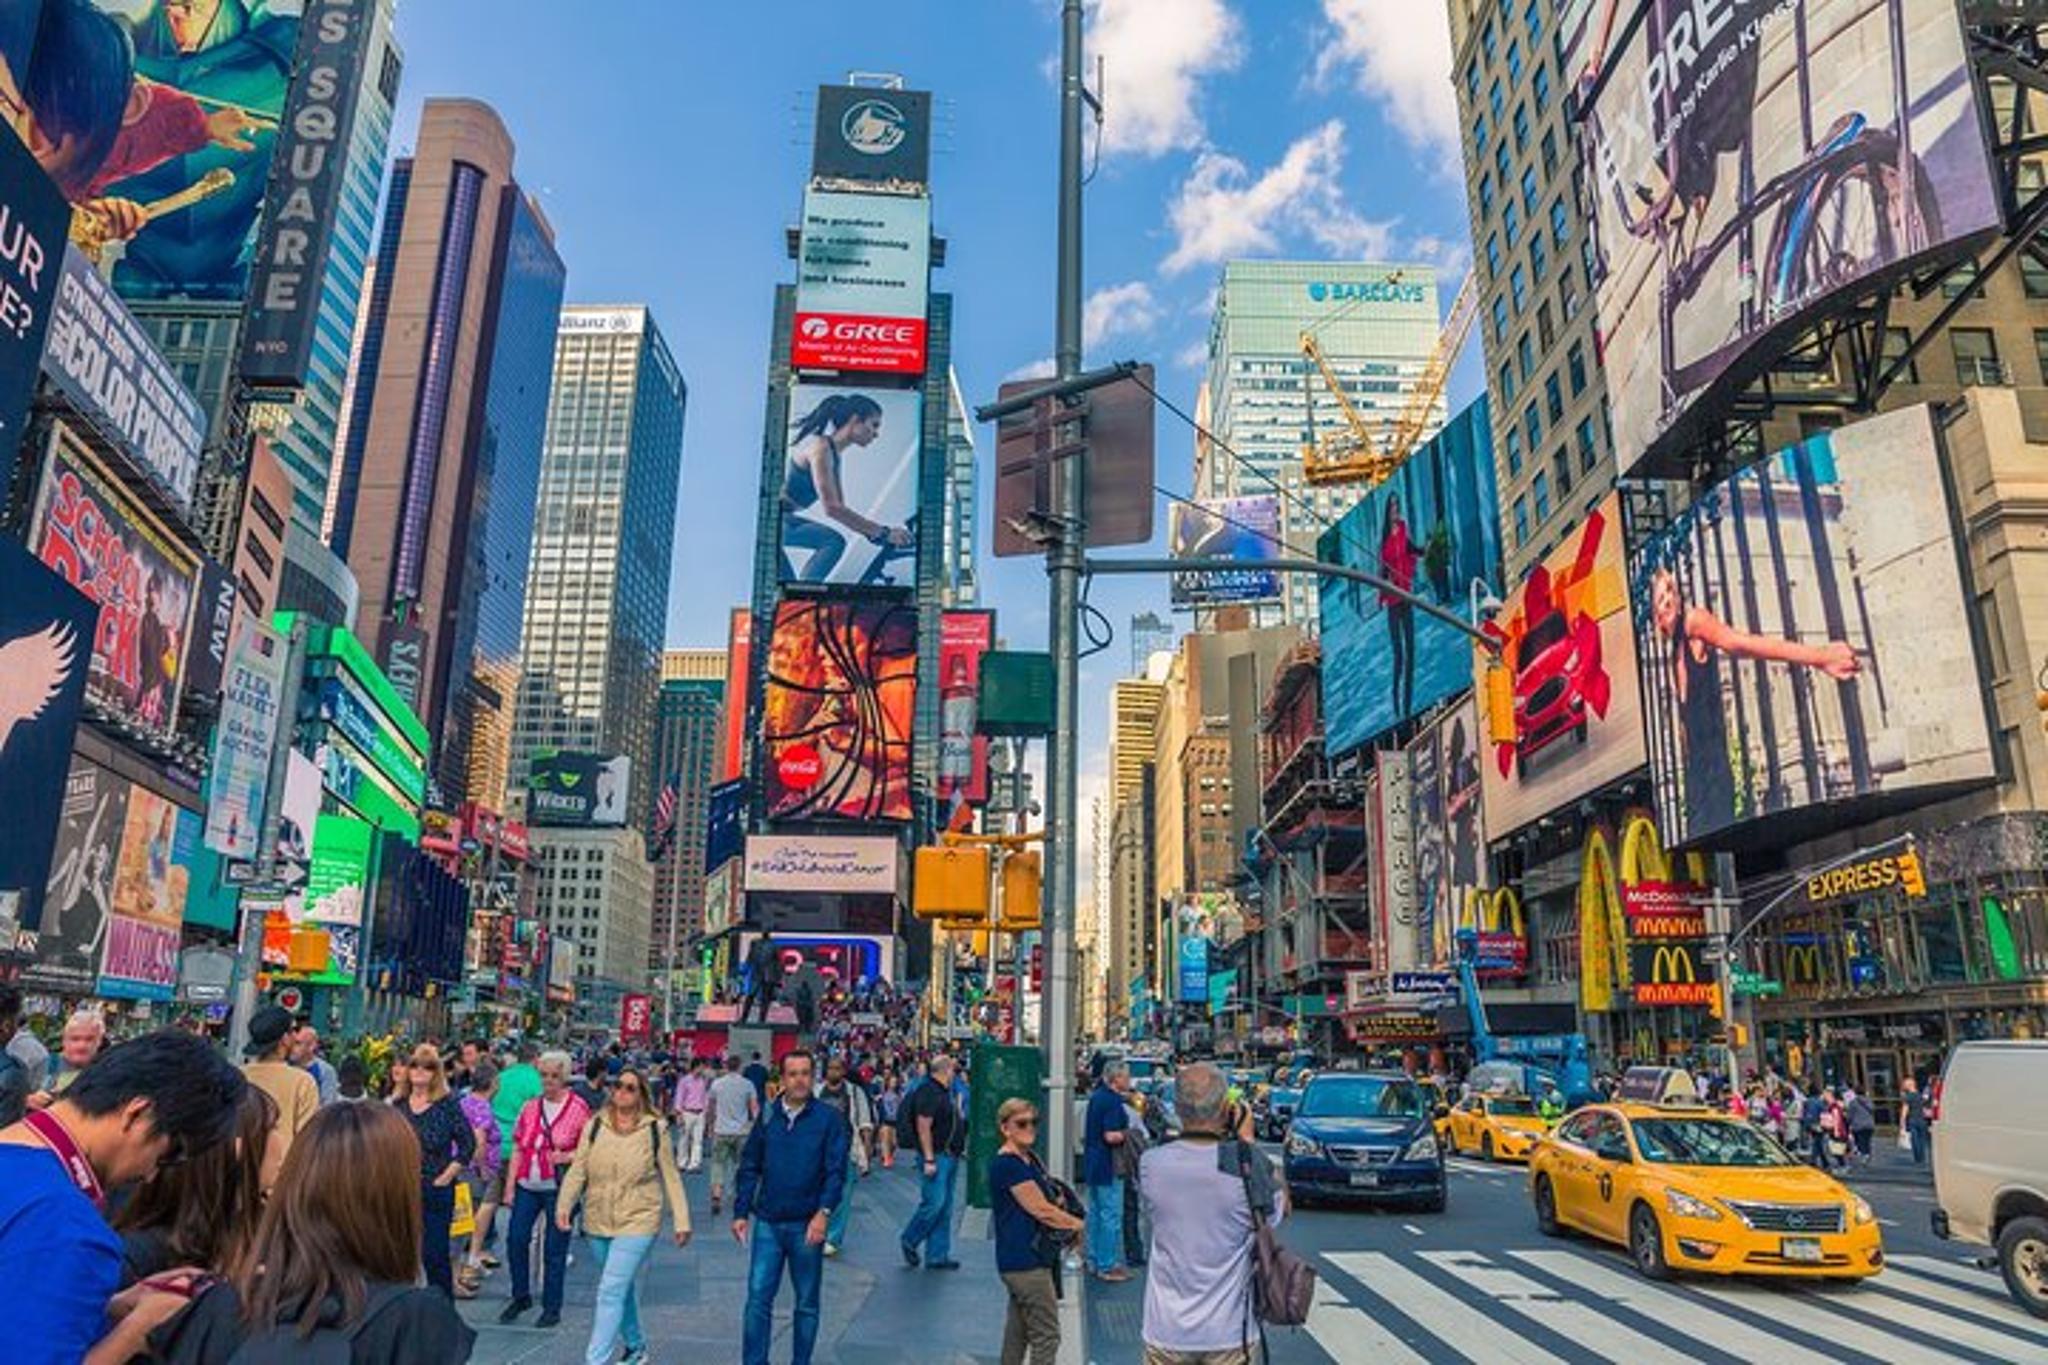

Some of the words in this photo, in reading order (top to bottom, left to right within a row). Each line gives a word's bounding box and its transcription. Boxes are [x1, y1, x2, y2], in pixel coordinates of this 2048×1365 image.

[264, 66, 339, 312] SQUARE
[830, 218, 884, 228] produce
[832, 275, 905, 288] businesses
[1329, 283, 1424, 302] BARCLAYS
[833, 323, 915, 343] GREE
[66, 321, 136, 436] COLOR
[131, 400, 197, 507] PURPLE
[209, 581, 236, 663] NEW
[1389, 766, 1413, 925] PALACE
[1807, 857, 1897, 901] EXPRESS
